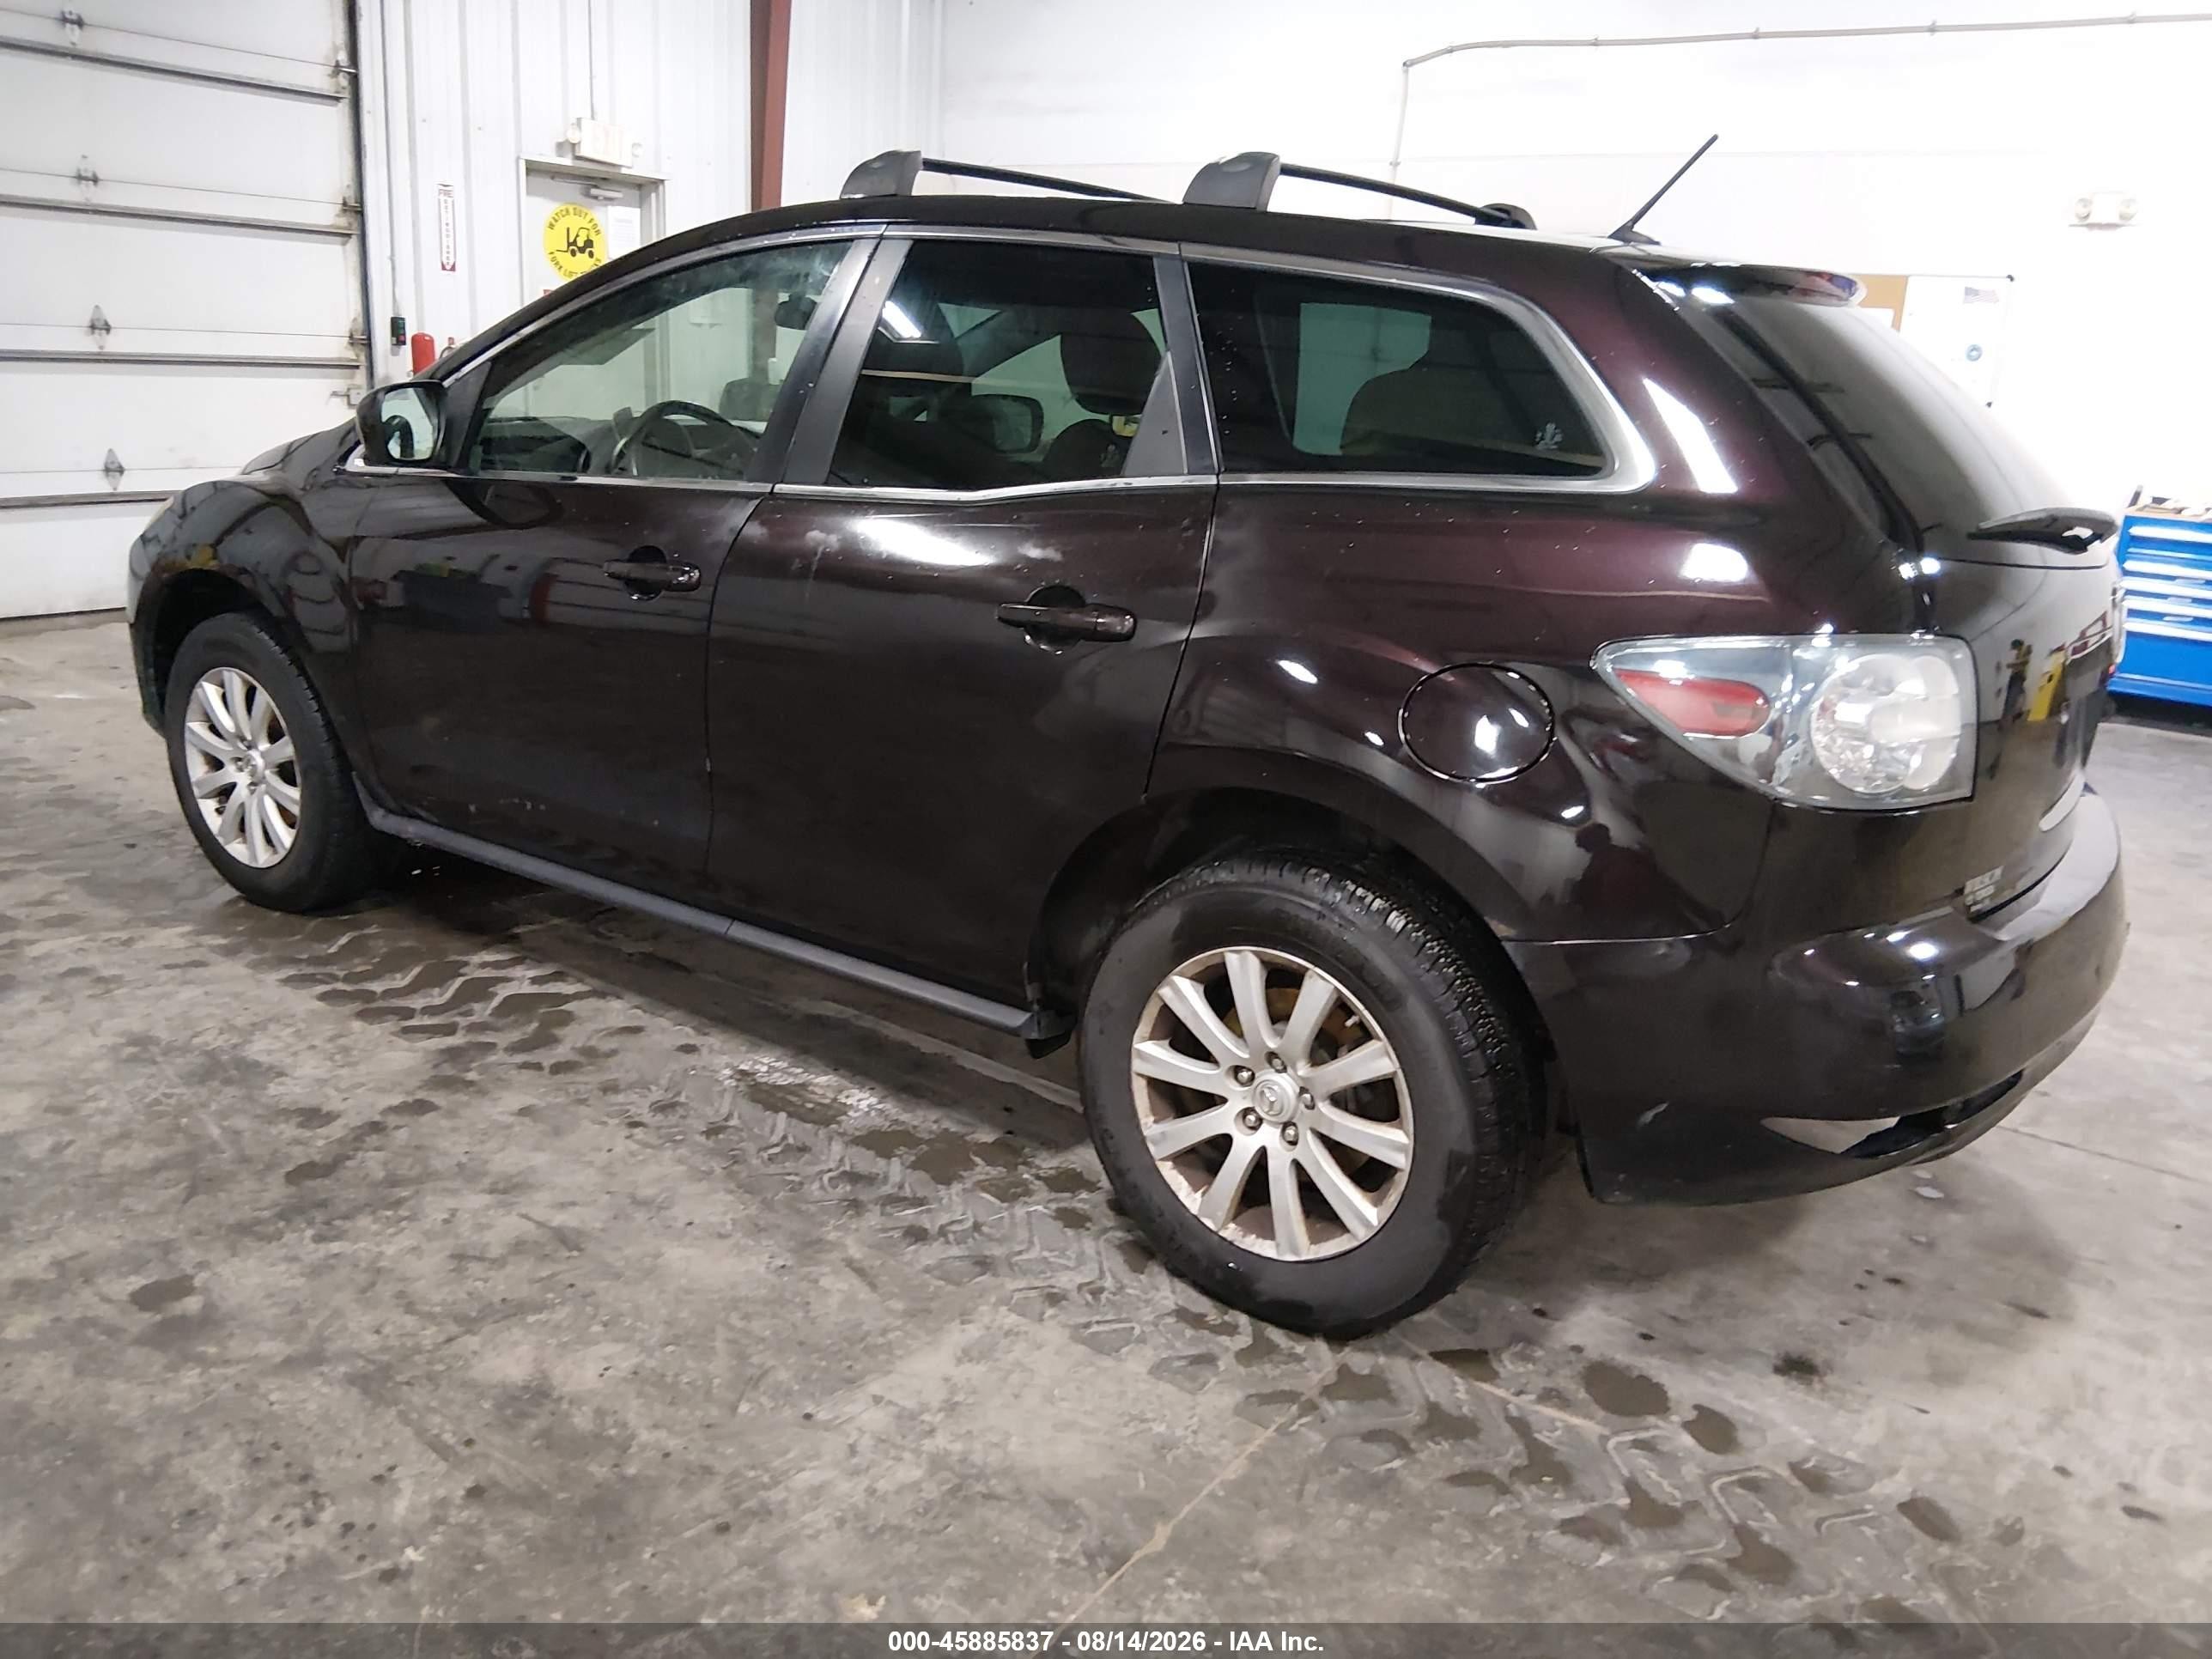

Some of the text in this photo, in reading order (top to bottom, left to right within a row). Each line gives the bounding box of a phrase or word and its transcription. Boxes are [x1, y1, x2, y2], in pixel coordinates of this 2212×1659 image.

[547, 207, 570, 230] WATCH
[573, 207, 588, 219] OUT
[587, 217, 602, 236] FOR
[548, 251, 563, 272] FORK
